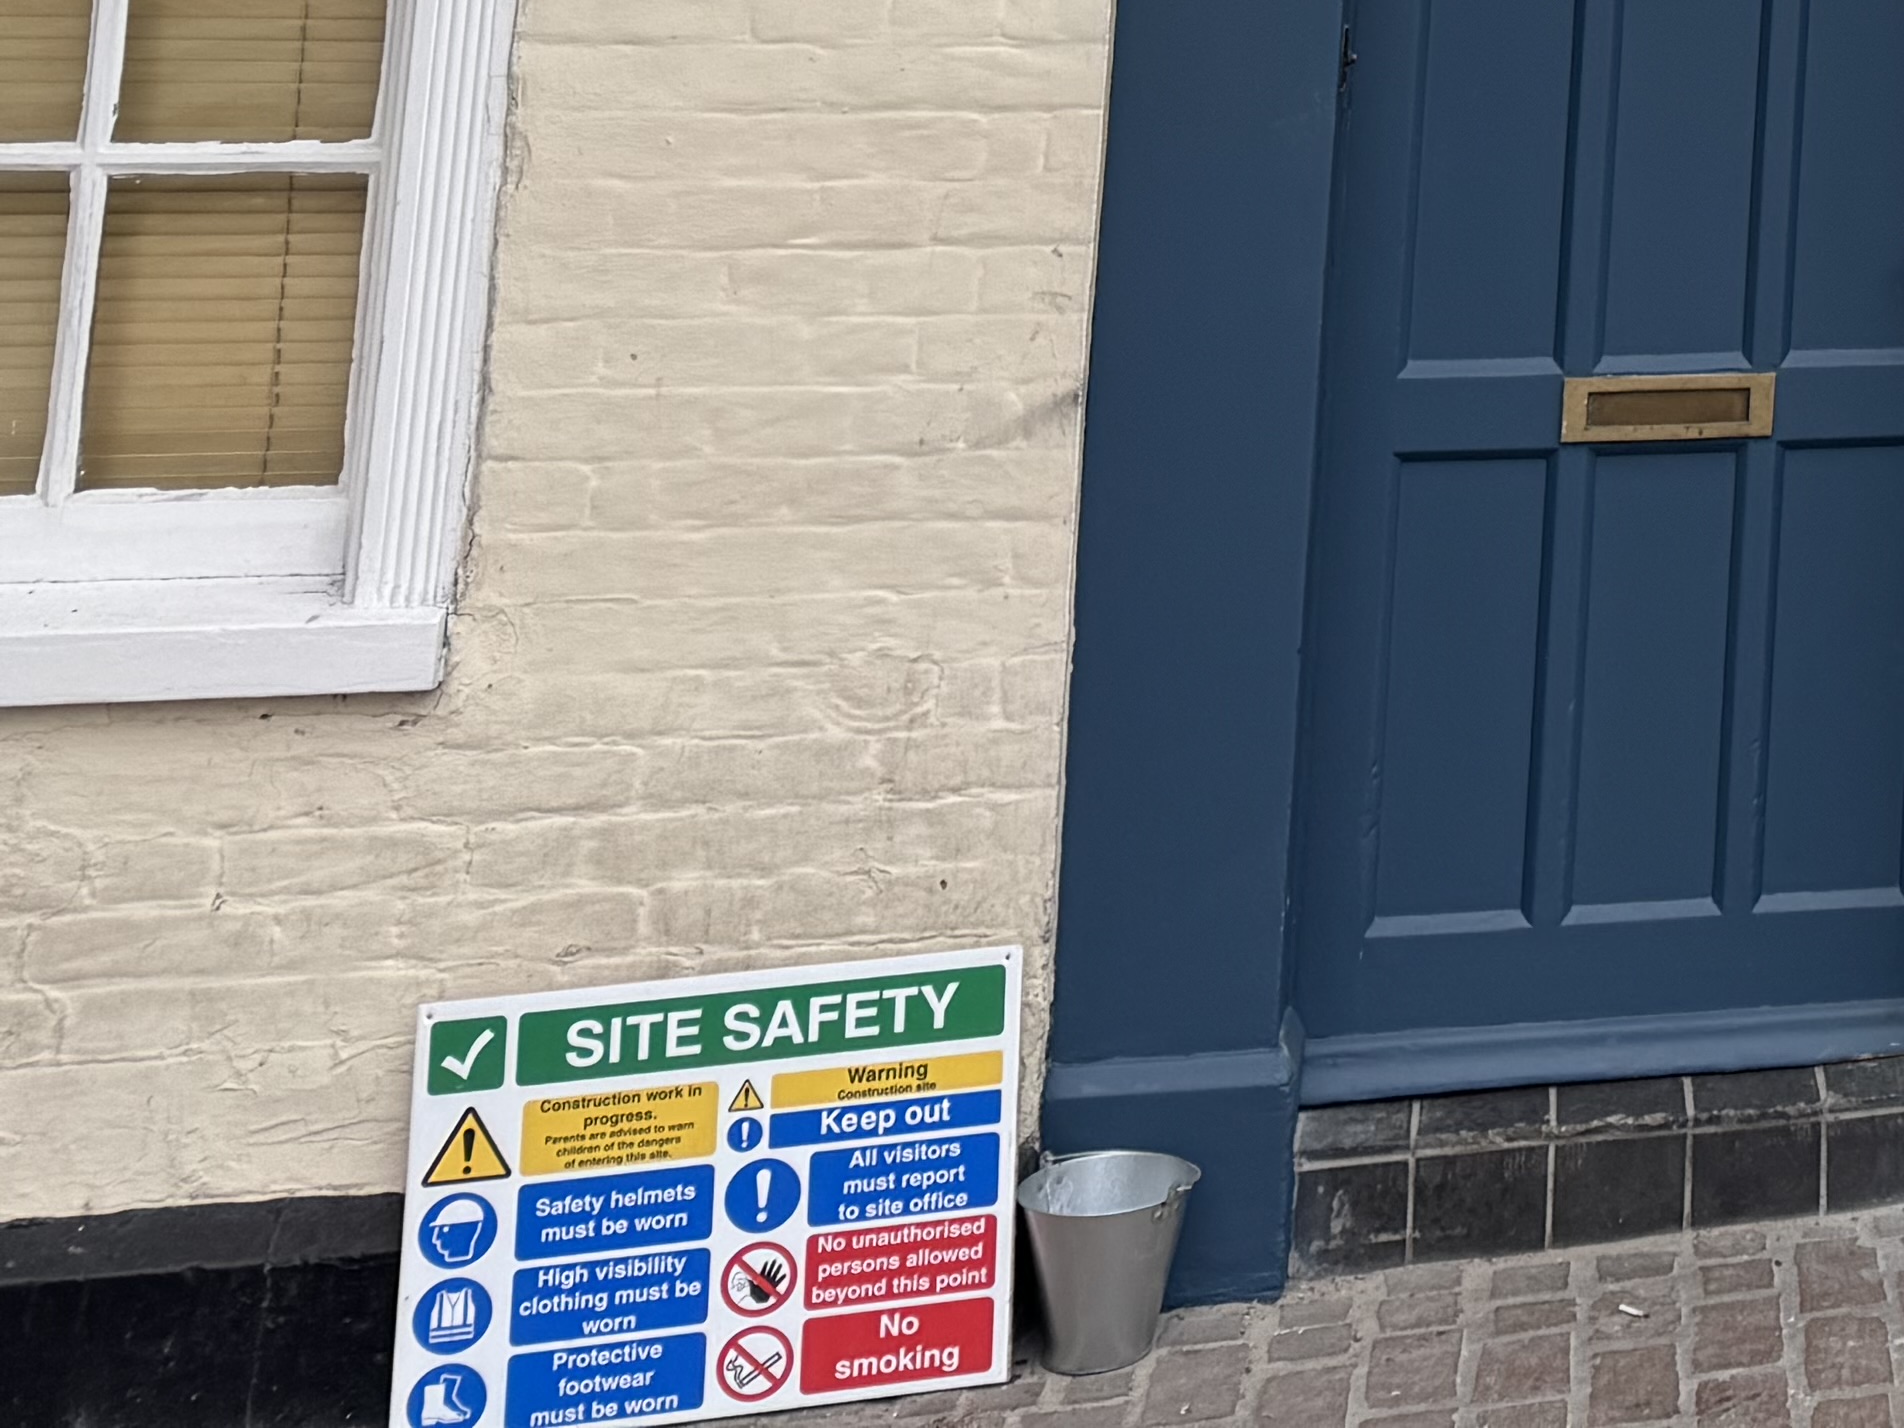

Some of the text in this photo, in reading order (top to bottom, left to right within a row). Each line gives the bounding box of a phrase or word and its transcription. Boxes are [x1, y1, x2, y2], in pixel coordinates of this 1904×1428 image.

[565, 981, 960, 1068] SITE SAFETY
[847, 1061, 929, 1085] Warning
[540, 1084, 702, 1114] Construction work in
[837, 1081, 937, 1101] Construction site
[583, 1109, 658, 1131] progress.
[819, 1098, 951, 1135] Keep out
[544, 1121, 695, 1145] Parents are advised to warn
[556, 1135, 681, 1157] children of the dangers
[564, 1157, 576, 1169] of
[578, 1154, 623, 1169] entering
[626, 1152, 646, 1162] this
[848, 1141, 961, 1169] All visitors
[842, 1164, 966, 1194] must report
[535, 1183, 697, 1217] Safety helmets
[838, 1191, 969, 1221] to site office
[540, 1212, 688, 1243] must be worn
[817, 1217, 986, 1254] No unauthorised
[537, 1255, 688, 1290] High visibility
[818, 1241, 984, 1282] persons allowed
[519, 1280, 702, 1317] clothing must be
[811, 1266, 988, 1305] beyond this point
[582, 1315, 637, 1335] worn
[879, 1312, 920, 1339] No
[552, 1341, 663, 1371] Protective
[834, 1344, 961, 1380] smoking
[557, 1369, 656, 1397] footwear
[529, 1394, 679, 1427] must be worn
